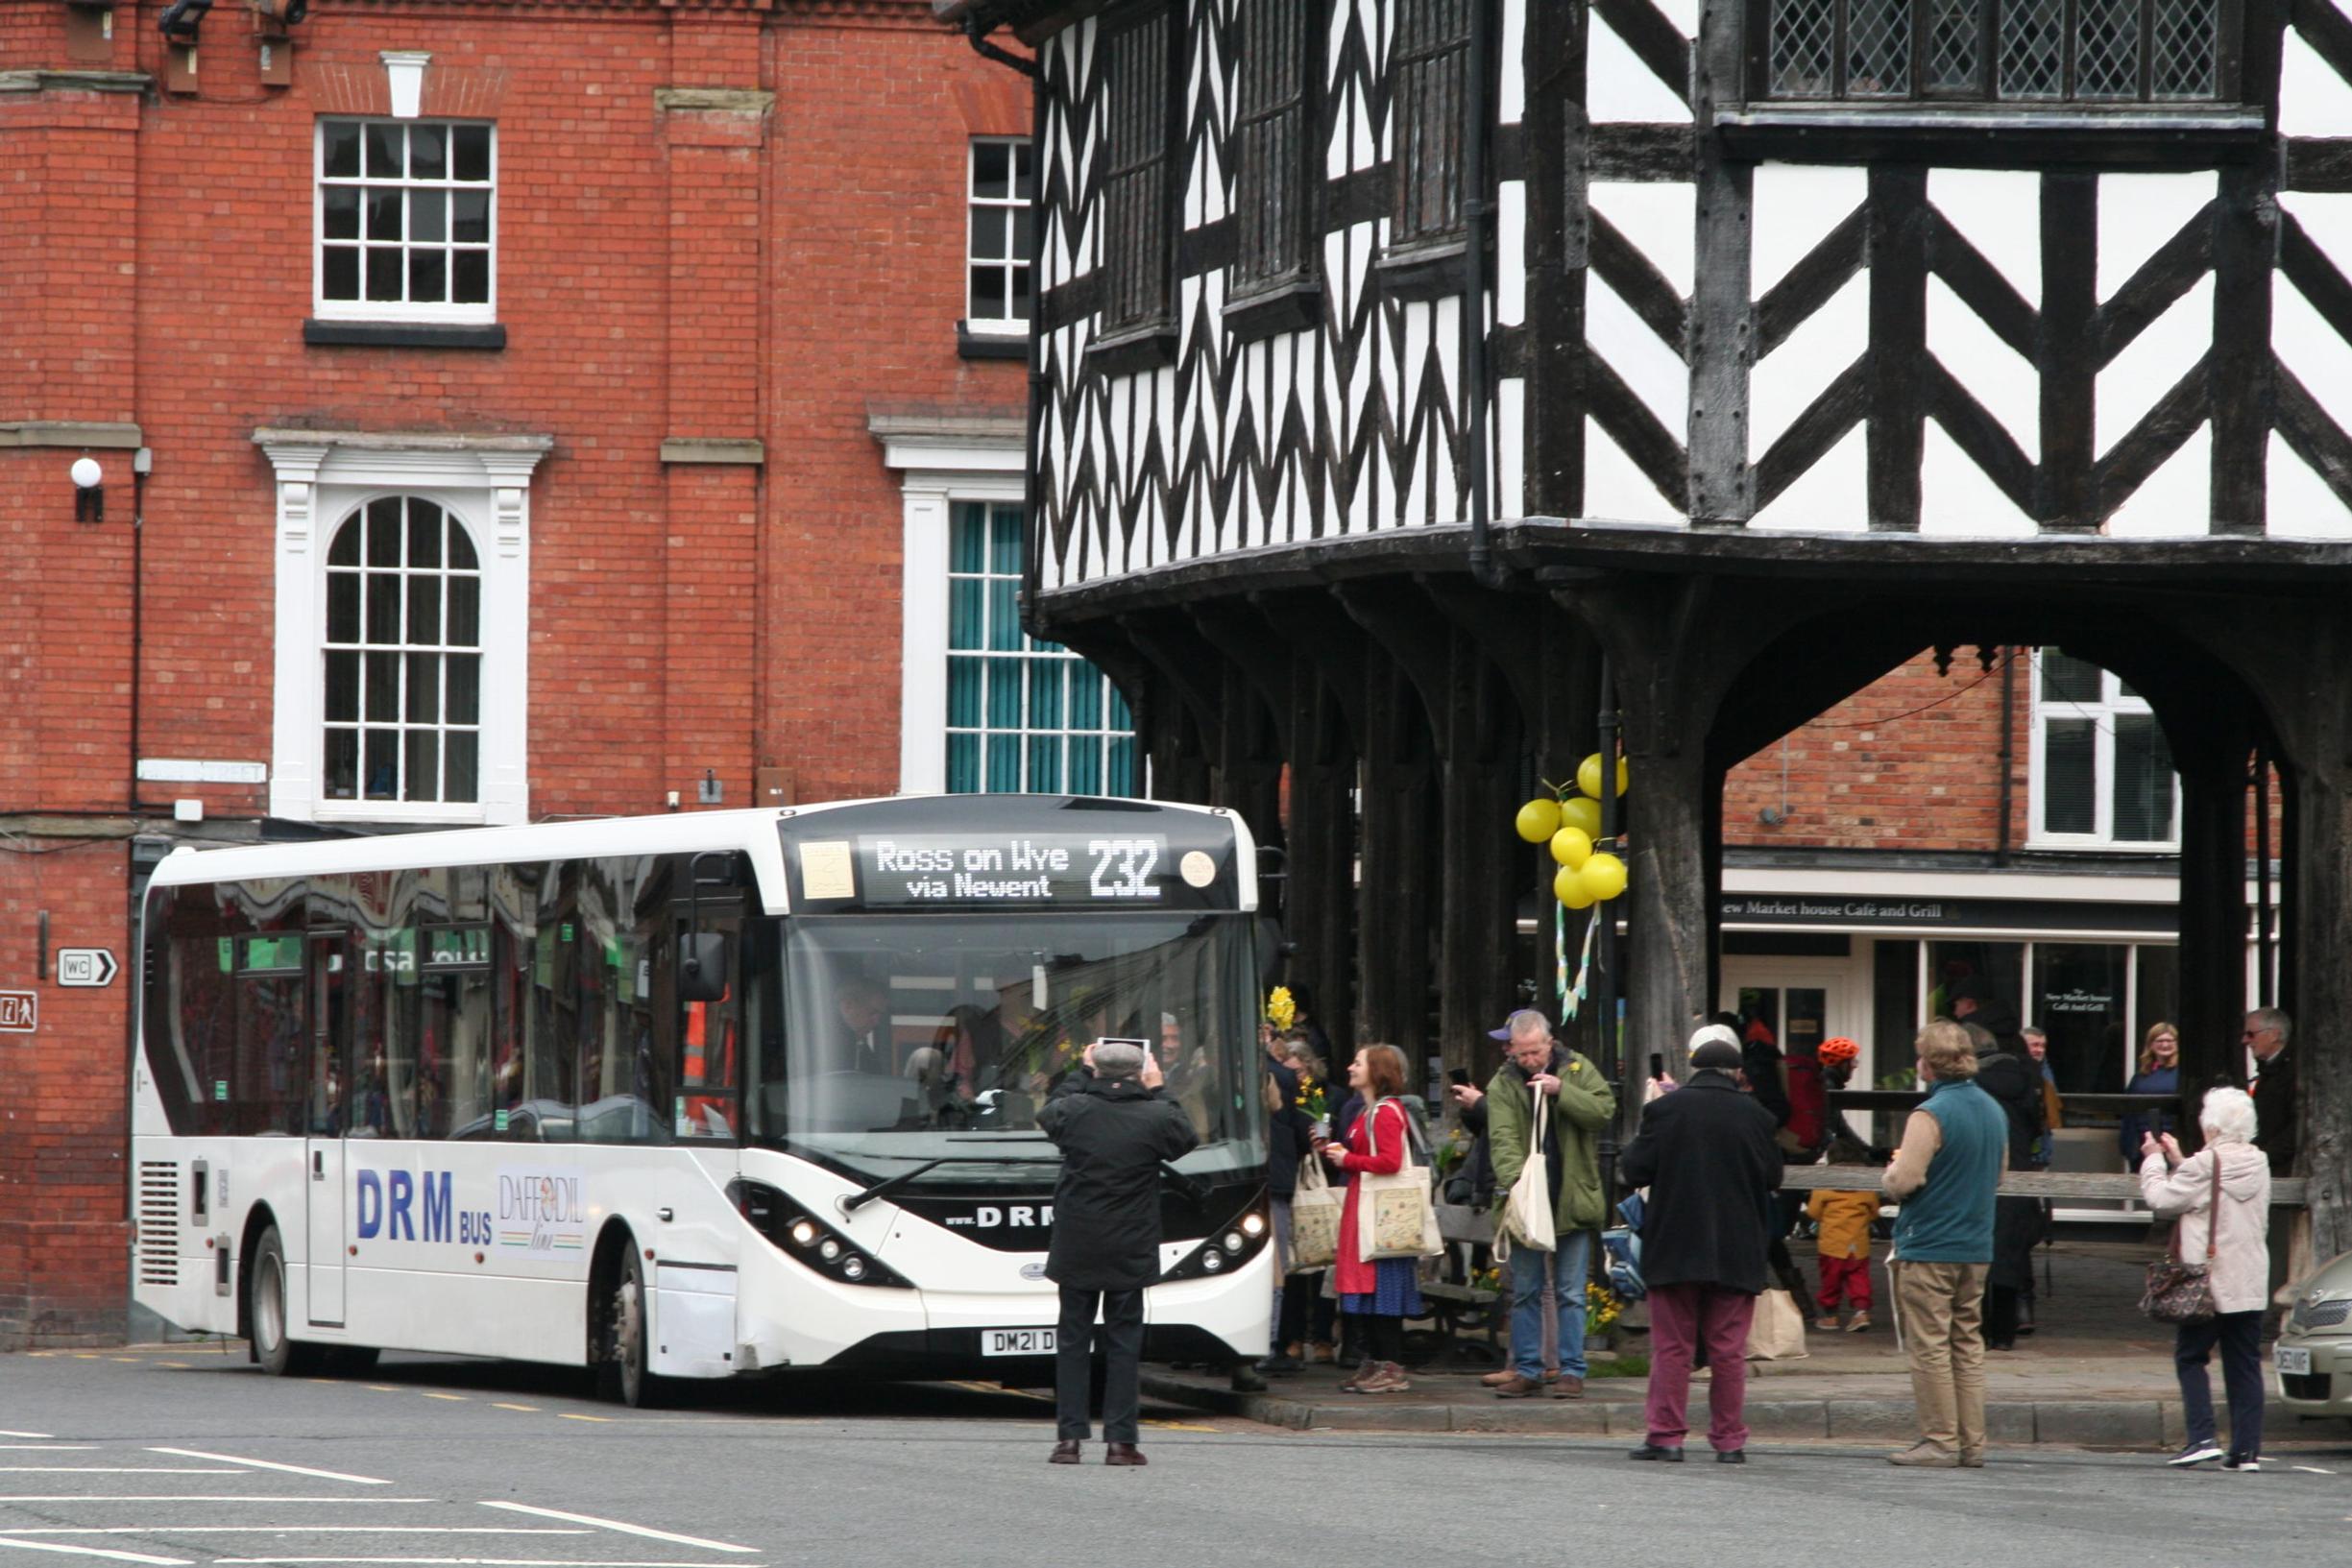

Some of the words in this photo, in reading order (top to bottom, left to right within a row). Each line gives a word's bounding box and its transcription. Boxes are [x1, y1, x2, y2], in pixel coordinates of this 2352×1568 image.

[877, 840, 954, 872] Ross
[963, 848, 1003, 871] on
[1011, 840, 1069, 871] Wye
[1088, 839, 1161, 897] 232
[907, 876, 948, 897] via
[954, 873, 1053, 898] Newent
[1722, 903, 1744, 913] ew
[1746, 901, 1797, 914] Market
[1800, 901, 1842, 915] house
[1879, 904, 1905, 917] and
[1908, 905, 1941, 917] Grill
[67, 961, 88, 975] WC
[357, 1169, 453, 1243] DRM
[460, 1211, 493, 1246] BUS
[499, 1174, 584, 1223] DAFFODIL
[994, 1332, 1036, 1352] DM21
